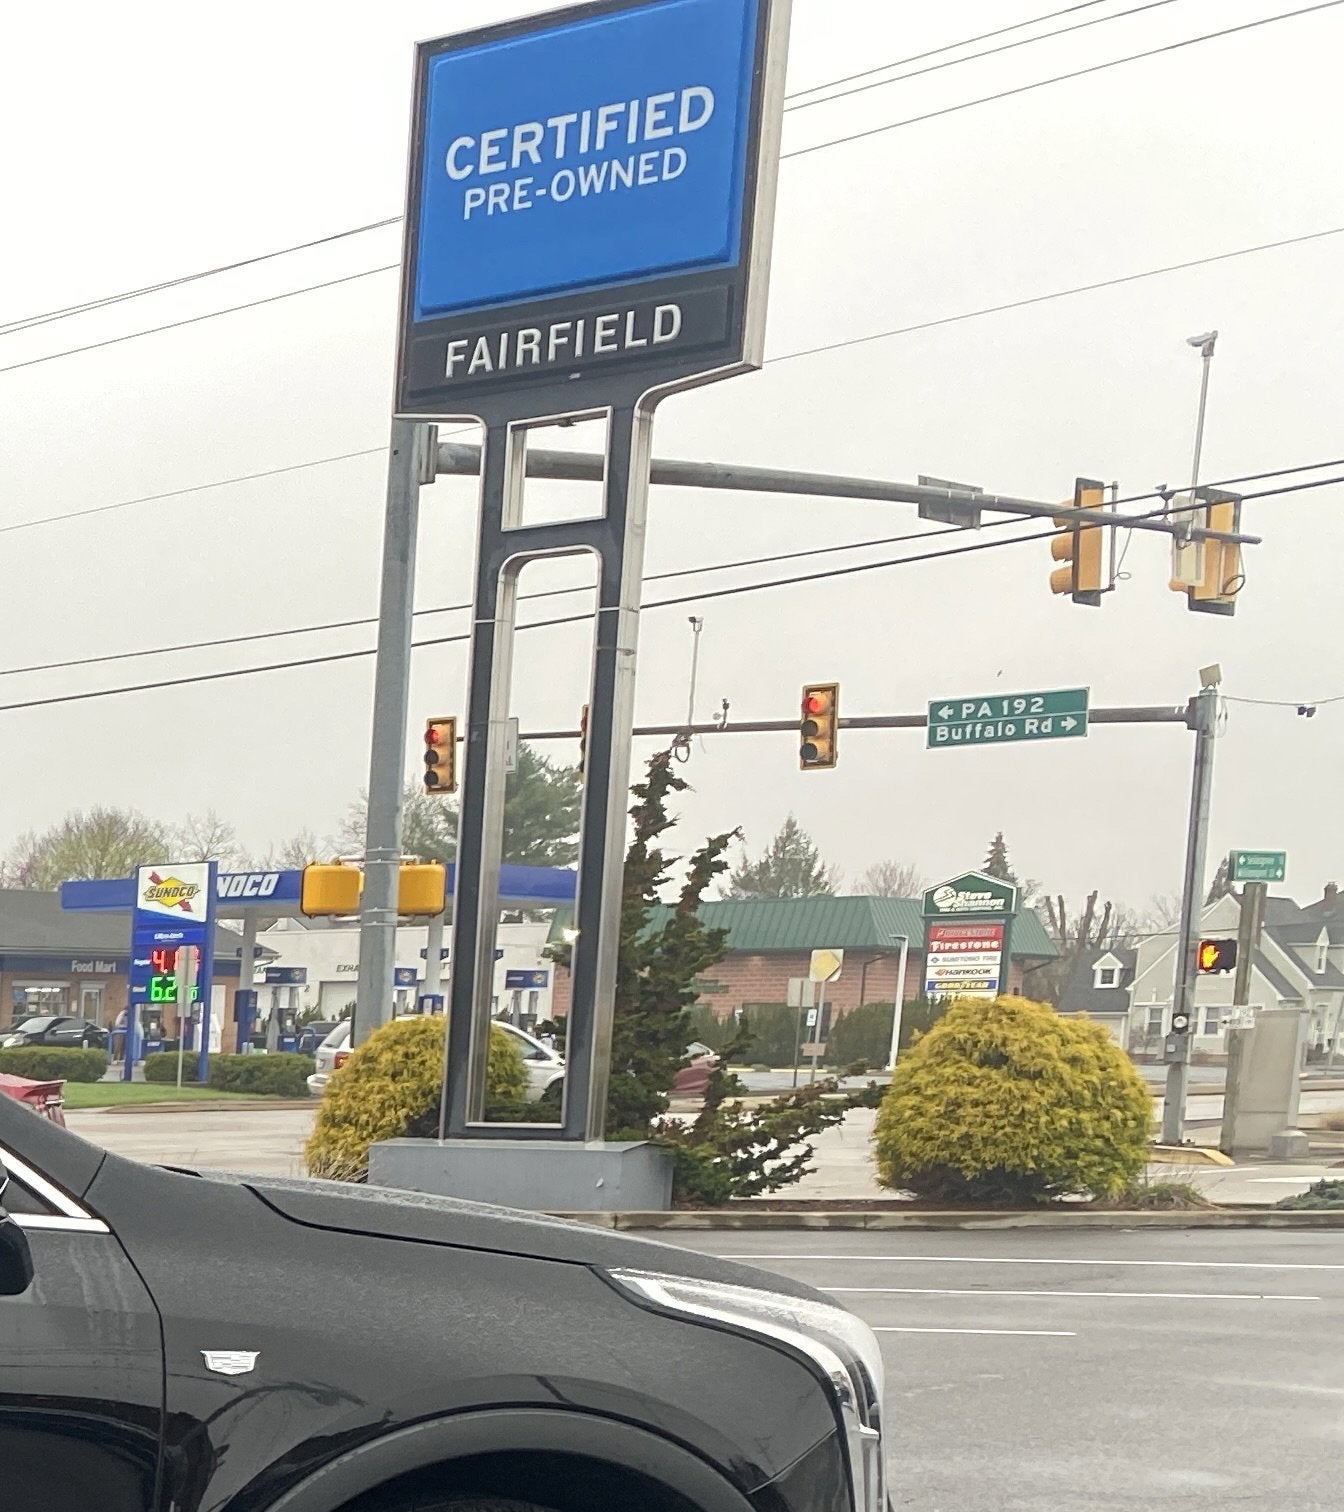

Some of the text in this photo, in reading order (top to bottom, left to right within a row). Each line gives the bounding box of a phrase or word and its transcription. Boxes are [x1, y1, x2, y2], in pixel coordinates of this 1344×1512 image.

[445, 85, 715, 181] CERTIFIED
[463, 146, 688, 221] PRE-OWNED
[445, 303, 683, 379] FAIRFIELD
[962, 697, 1045, 719] PA 192
[936, 718, 1053, 742] Buffalo Rd
[148, 885, 196, 900] SUNOCO
[957, 892, 992, 900] Steve
[931, 941, 999, 952] Firestone
[72, 960, 117, 973] Food Mart
